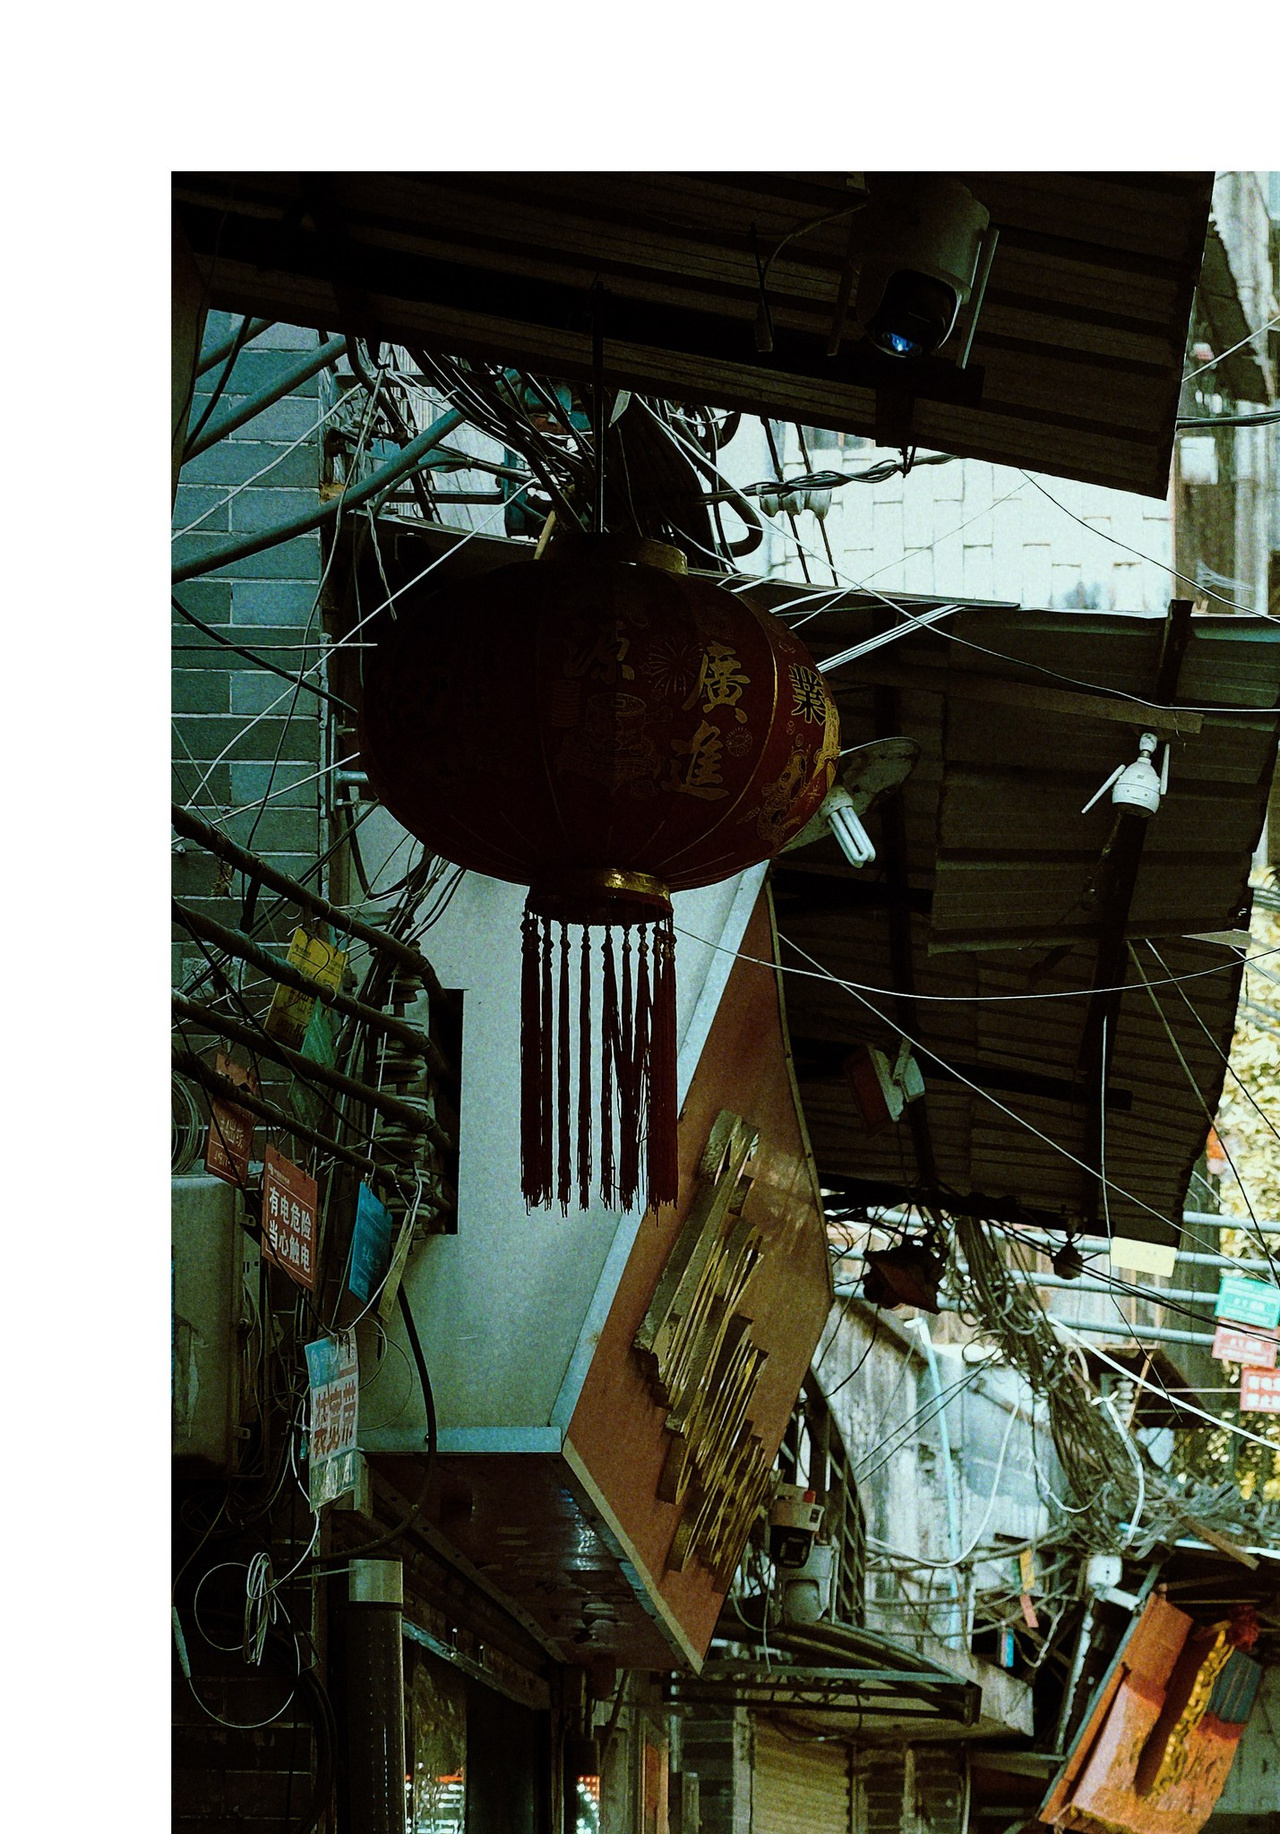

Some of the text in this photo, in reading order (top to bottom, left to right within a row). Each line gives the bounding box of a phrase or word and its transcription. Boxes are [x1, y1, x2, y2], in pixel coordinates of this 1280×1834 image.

[268, 1186, 311, 1241] 有电危险
[268, 1219, 310, 1274] 当心触电
